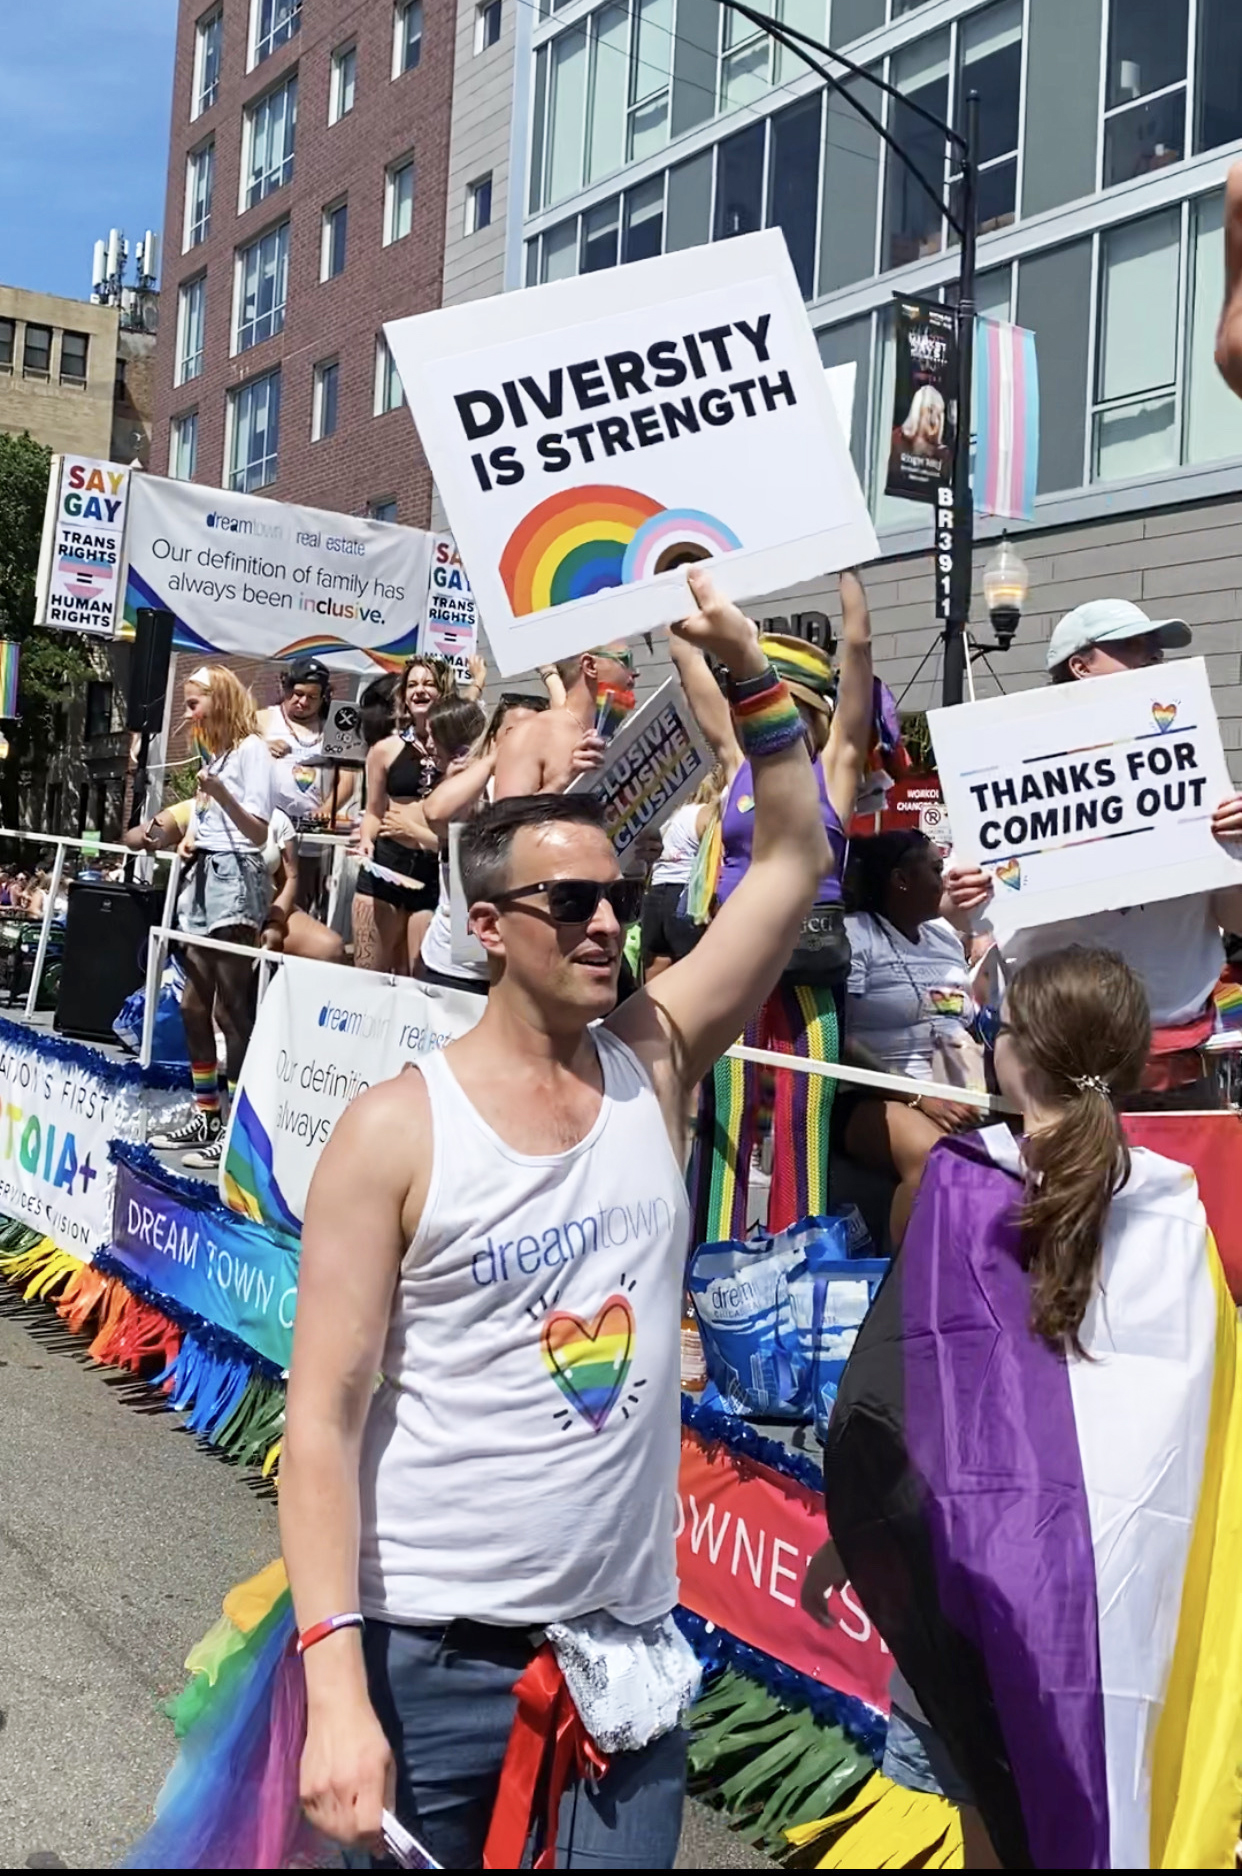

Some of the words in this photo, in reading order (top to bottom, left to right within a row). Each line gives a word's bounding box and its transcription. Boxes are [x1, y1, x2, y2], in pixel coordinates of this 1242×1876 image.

[453, 313, 771, 442] DIVERSITY
[470, 445, 525, 492] IS
[535, 369, 797, 473] STRENGTH
[68, 465, 125, 496] SAY
[63, 492, 122, 523] GAY
[58, 544, 117, 564] RIGHTS
[62, 530, 116, 550] TRANS
[296, 530, 321, 549] real
[326, 536, 365, 557] estate
[436, 542, 464, 567] SA
[938, 487, 954, 617] BR3911
[152, 538, 192, 563] Our
[198, 547, 286, 580] definition
[293, 565, 311, 584] of
[316, 568, 369, 598] family
[373, 578, 405, 601] has
[433, 566, 471, 593] GA
[51, 594, 113, 614] HUMAN
[51, 608, 110, 628] RIGHTS
[168, 572, 236, 603] always
[242, 584, 292, 610] been
[299, 592, 385, 625] inclusive.
[429, 608, 475, 625] RIGHTS
[432, 596, 475, 612] TRANS
[593, 706, 678, 803] LUSIVE
[969, 757, 1116, 812] THANKS
[1126, 741, 1198, 782] FOR
[979, 794, 1124, 851] COMING
[1136, 777, 1207, 819] OUT
[276, 1049, 298, 1084] Our
[300, 1060, 370, 1101] definitio
[61, 1081, 110, 1123] FIRST
[276, 1100, 332, 1147] always
[0, 1100, 98, 1197] TQIA+
[128, 1199, 200, 1270] DREAM
[206, 1240, 275, 1315] TOWN
[472, 1197, 674, 1286] dreamtown
[674, 1491, 890, 1653] WNES
